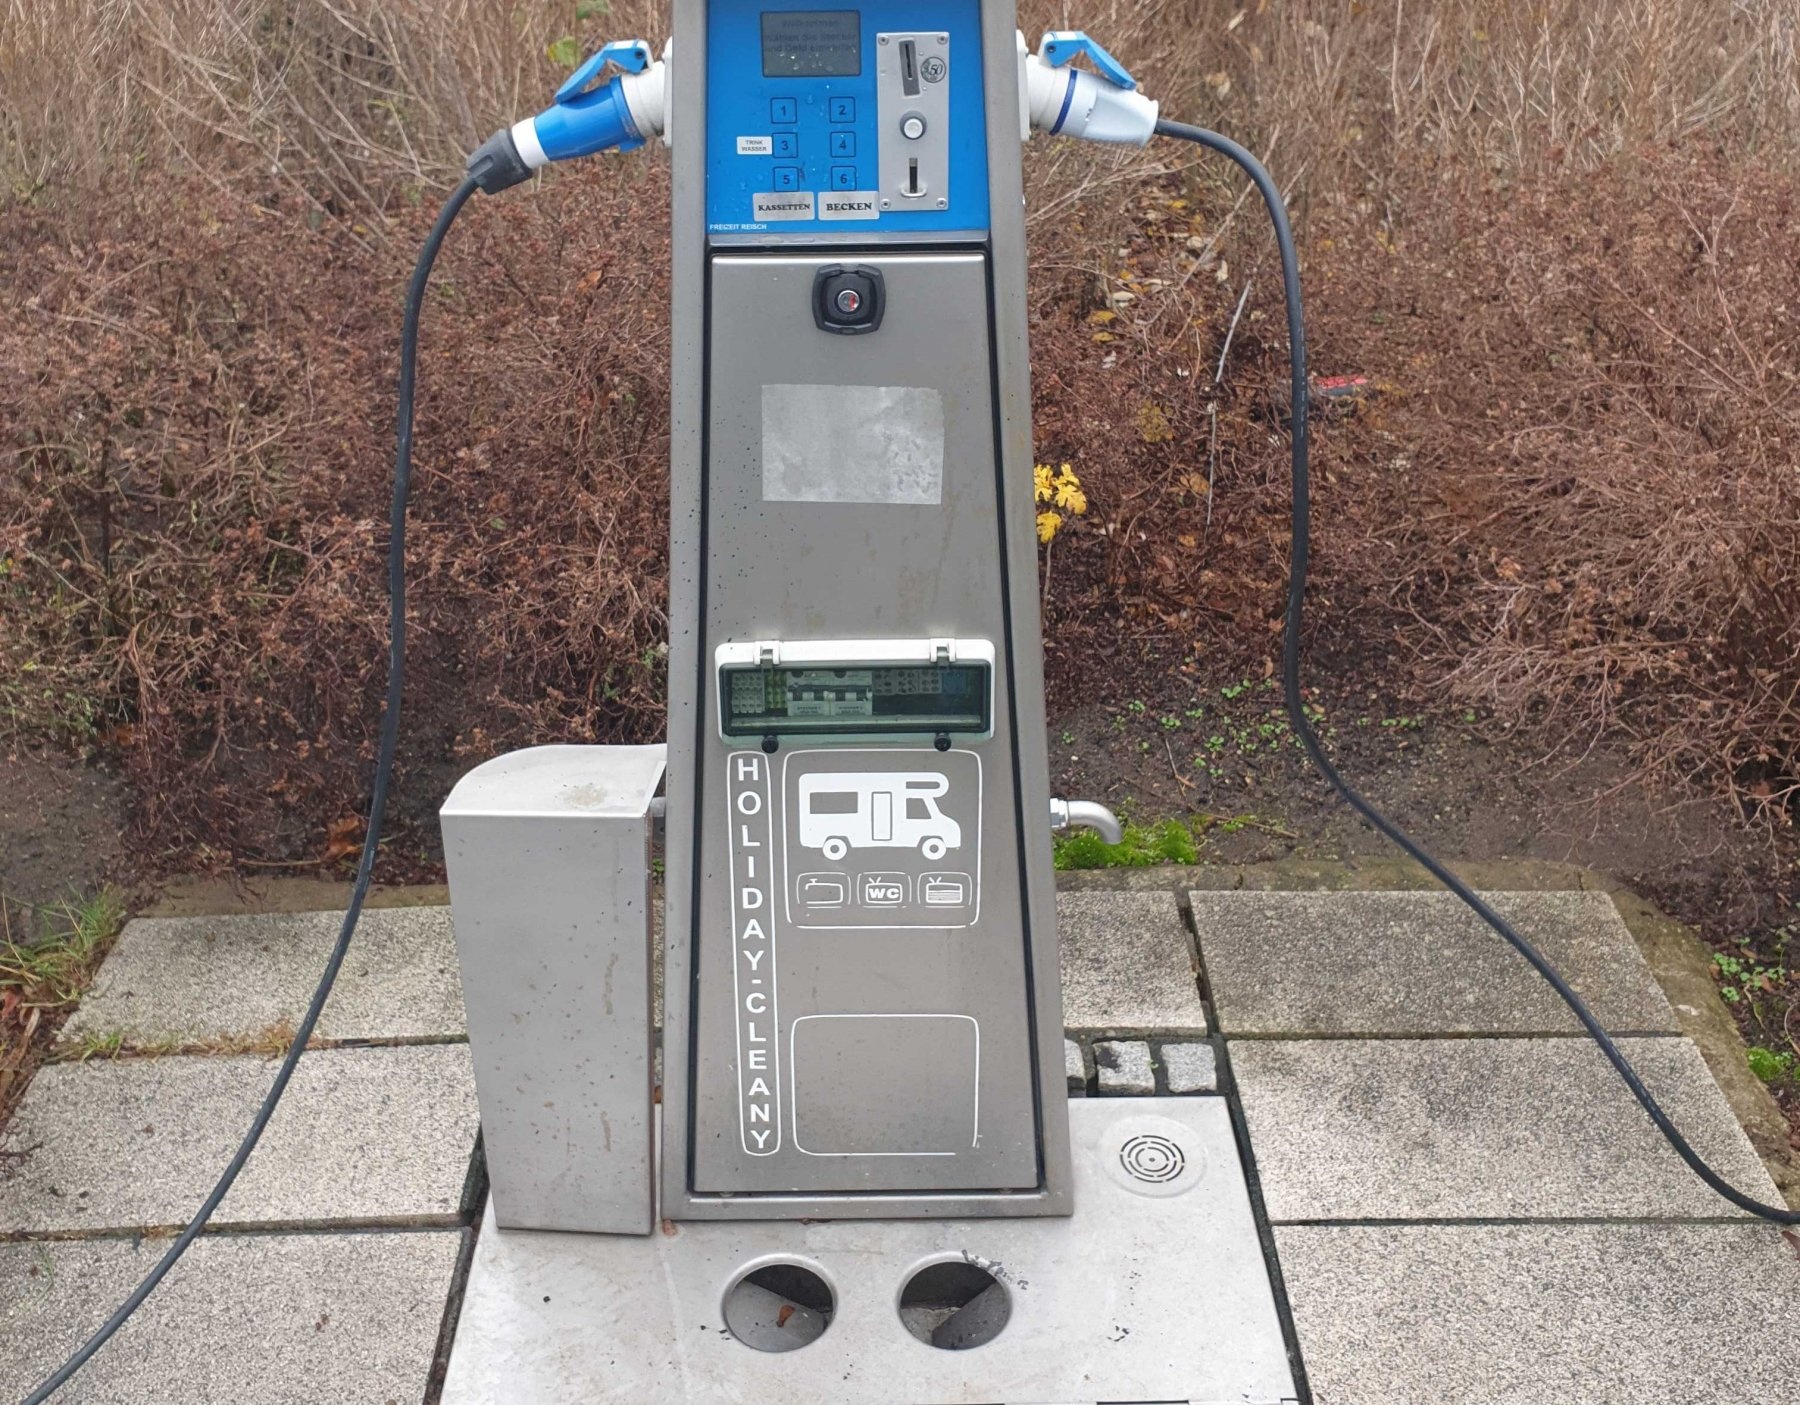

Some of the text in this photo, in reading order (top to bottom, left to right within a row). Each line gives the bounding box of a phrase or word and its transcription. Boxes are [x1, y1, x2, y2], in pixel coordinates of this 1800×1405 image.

[929, 63, 943, 76] 50
[780, 105, 787, 116] 1
[838, 104, 847, 116] 2
[780, 140, 789, 151] 3
[839, 139, 847, 150] 4
[782, 174, 791, 185] 5
[839, 173, 848, 184] 6
[758, 203, 811, 212] KASSETTEN
[826, 202, 873, 211] BECKEN
[709, 223, 739, 231] FREIZEIT
[868, 886, 900, 900] WC
[737, 758, 771, 1149] HOLIDAY-CLEANY
